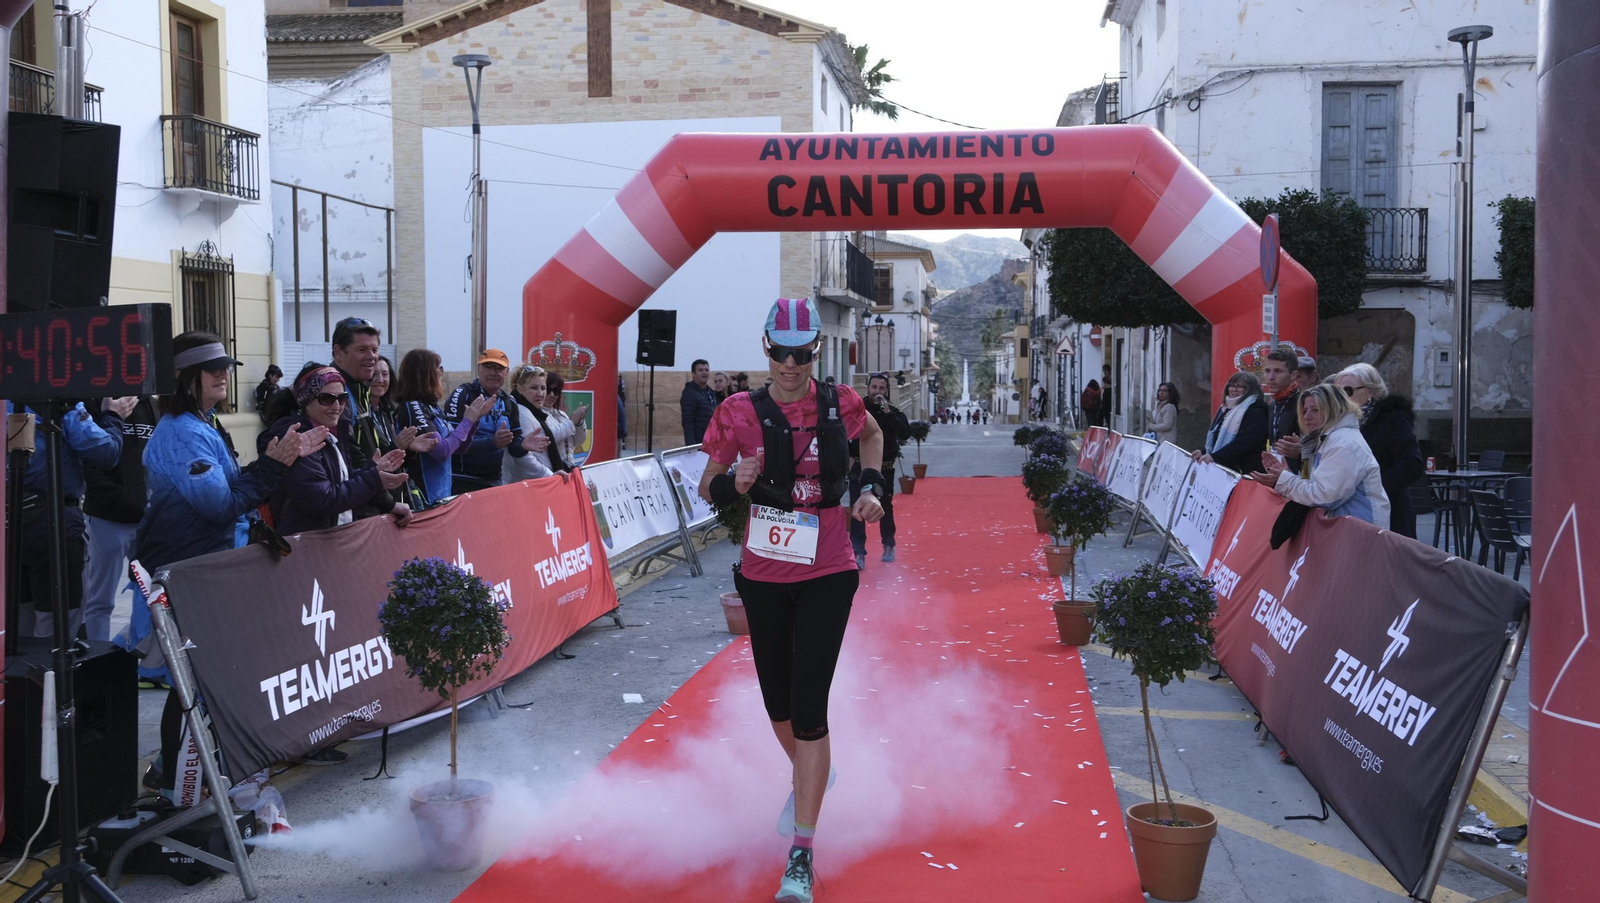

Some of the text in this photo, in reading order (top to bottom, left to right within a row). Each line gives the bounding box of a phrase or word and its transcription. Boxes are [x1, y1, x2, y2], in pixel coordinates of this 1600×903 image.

[758, 132, 1055, 161] AYUNTAMIENTO
[766, 171, 1045, 218] CANTORIA
[0, 313, 147, 388] :40:56
[769, 525, 796, 547] 67
[1250, 588, 1308, 654] TEAMERGY
[260, 635, 394, 721] TEAMERGY
[1323, 648, 1437, 747] TEAMERGY
[1323, 717, 1384, 774] www.teamergy.es
